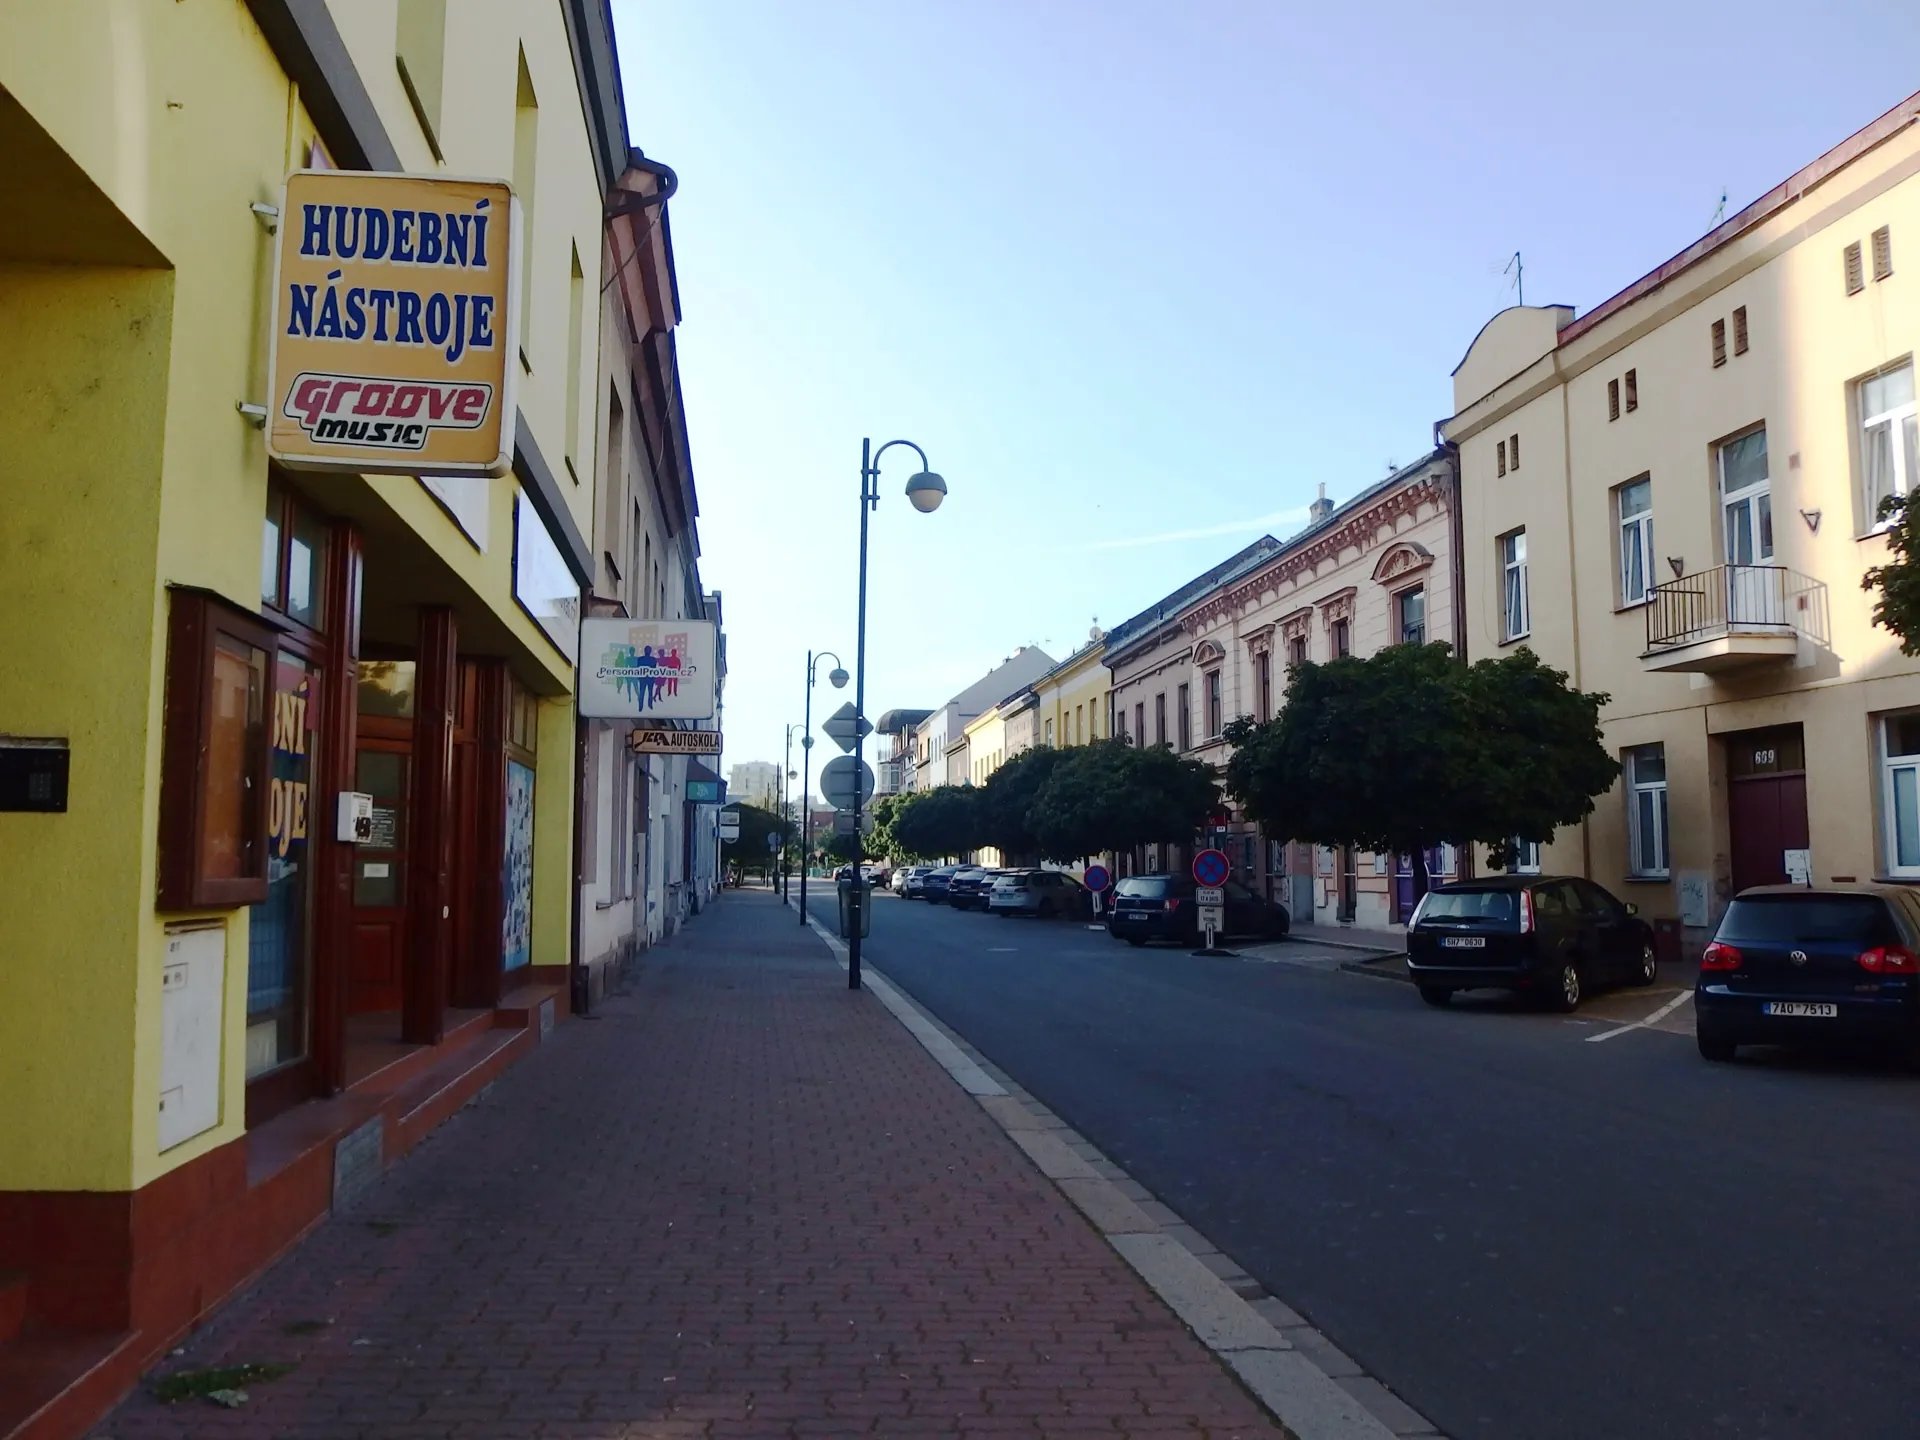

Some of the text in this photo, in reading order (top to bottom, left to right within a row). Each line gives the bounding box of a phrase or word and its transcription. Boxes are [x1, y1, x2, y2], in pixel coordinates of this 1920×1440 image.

[300, 198, 489, 267] HUDEBNÍ
[287, 269, 494, 362] NÁSTROJE
[294, 379, 486, 424] groove
[1803, 1003, 1832, 1016] 7513
